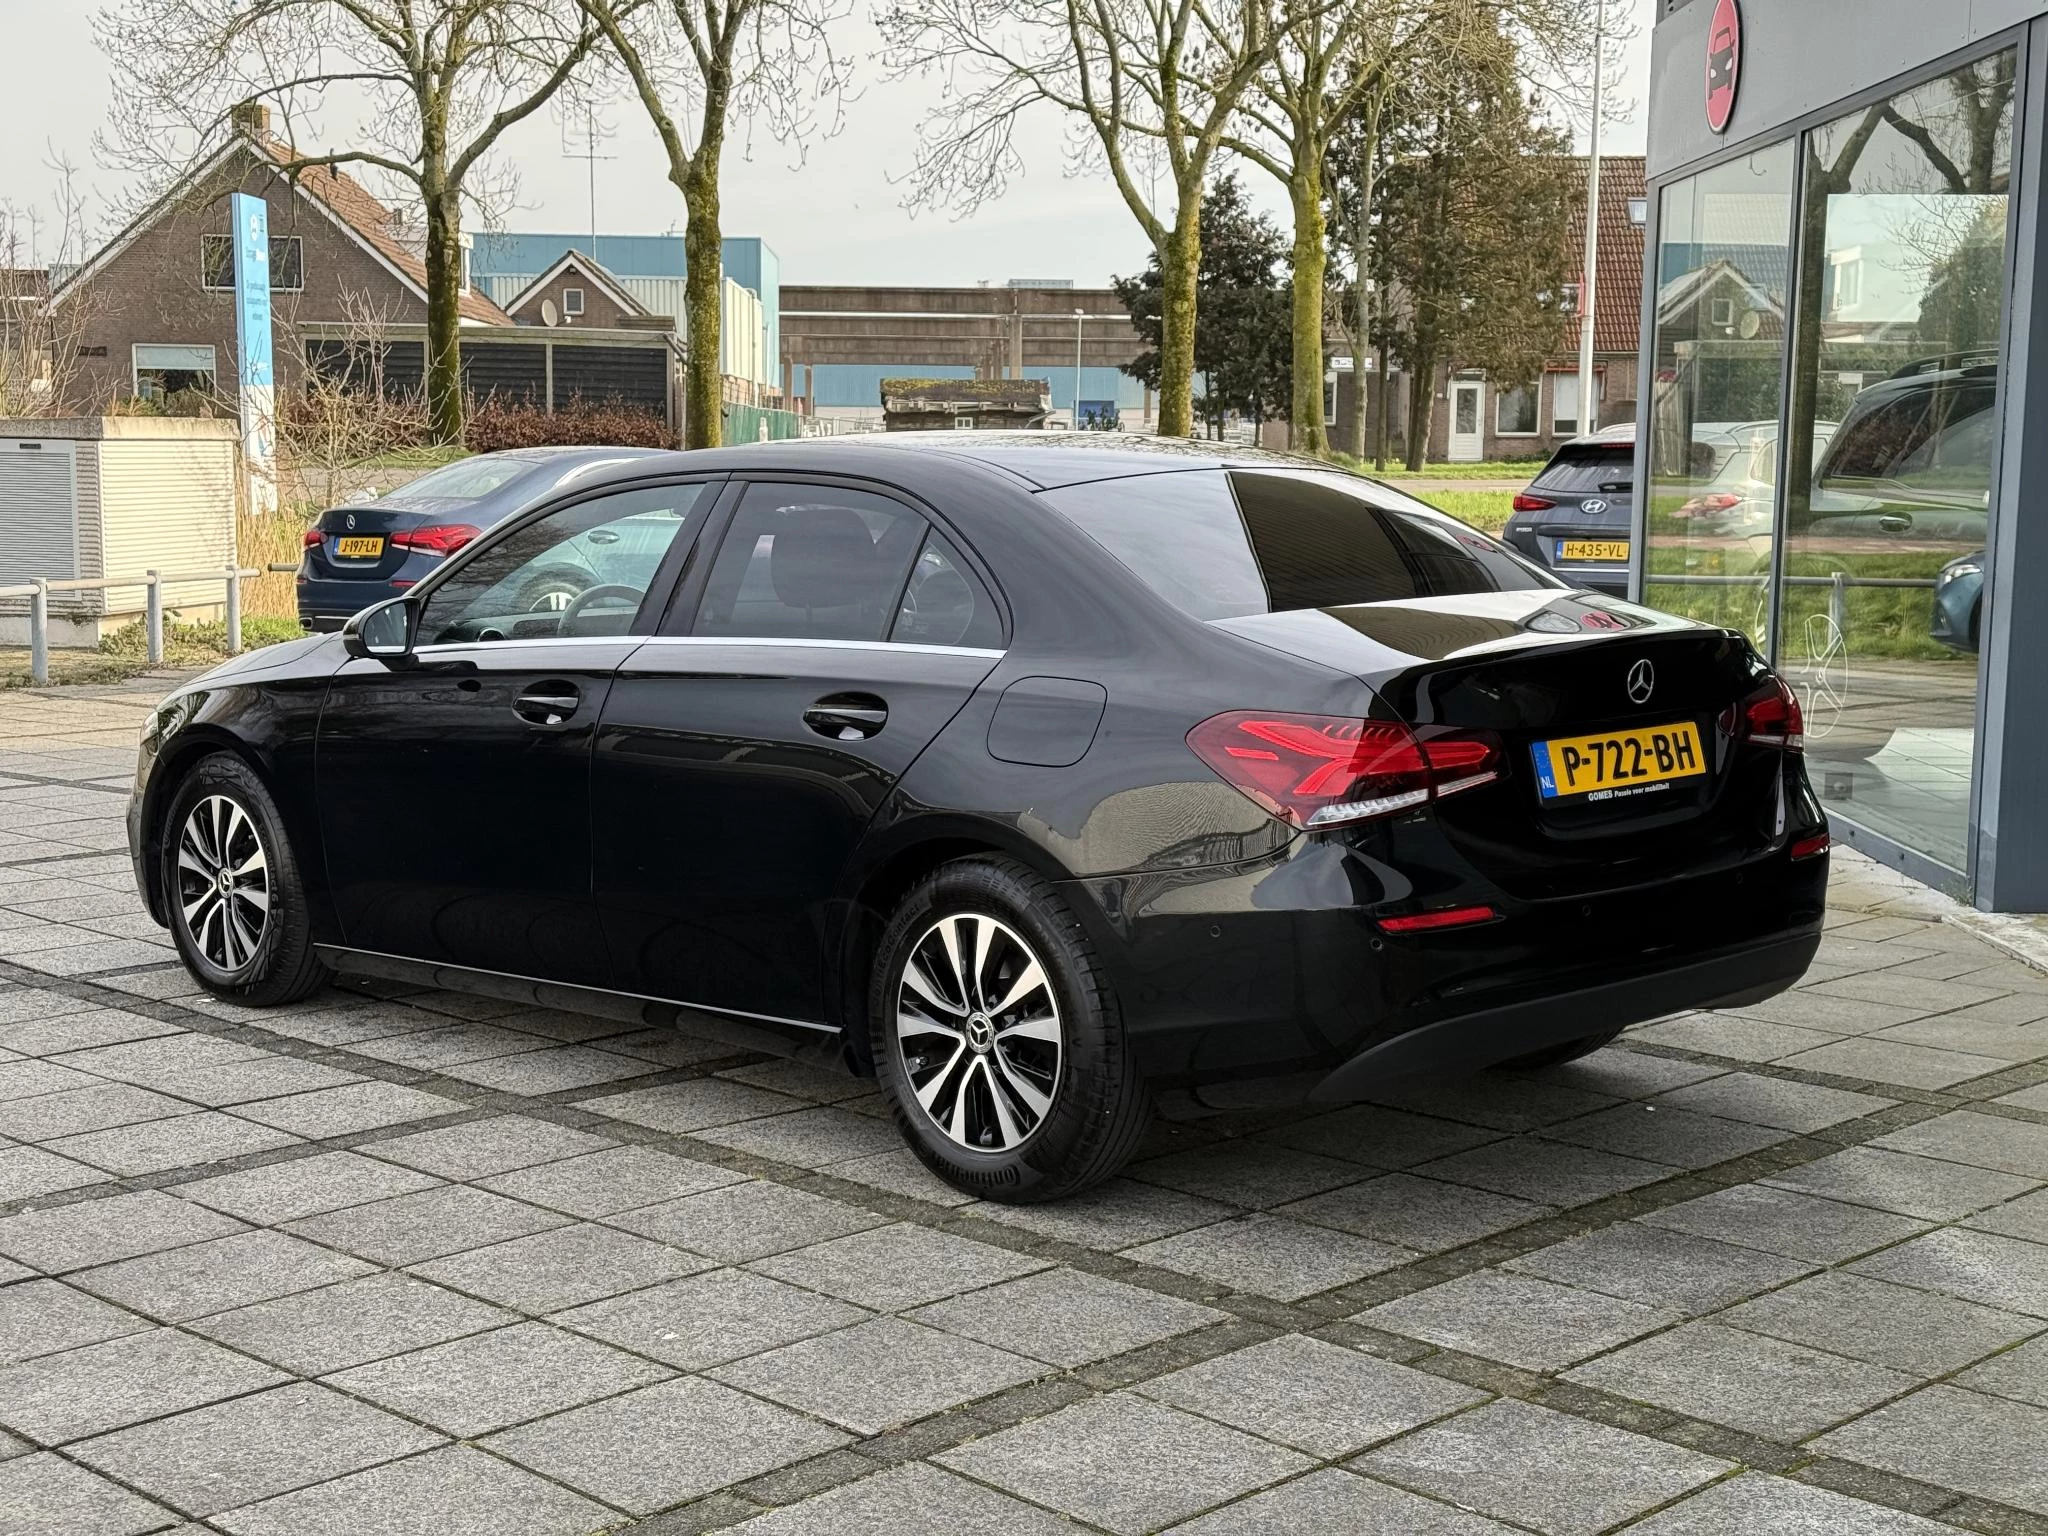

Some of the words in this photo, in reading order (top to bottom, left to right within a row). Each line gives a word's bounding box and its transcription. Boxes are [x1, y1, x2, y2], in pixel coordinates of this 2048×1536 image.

[341, 540, 379, 553] J-197-LH
[1566, 543, 1624, 558] H-435-VL
[1560, 729, 1697, 788] P-722-BH
[1541, 775, 1556, 790] NL
[1588, 789, 1613, 802] GOMES
